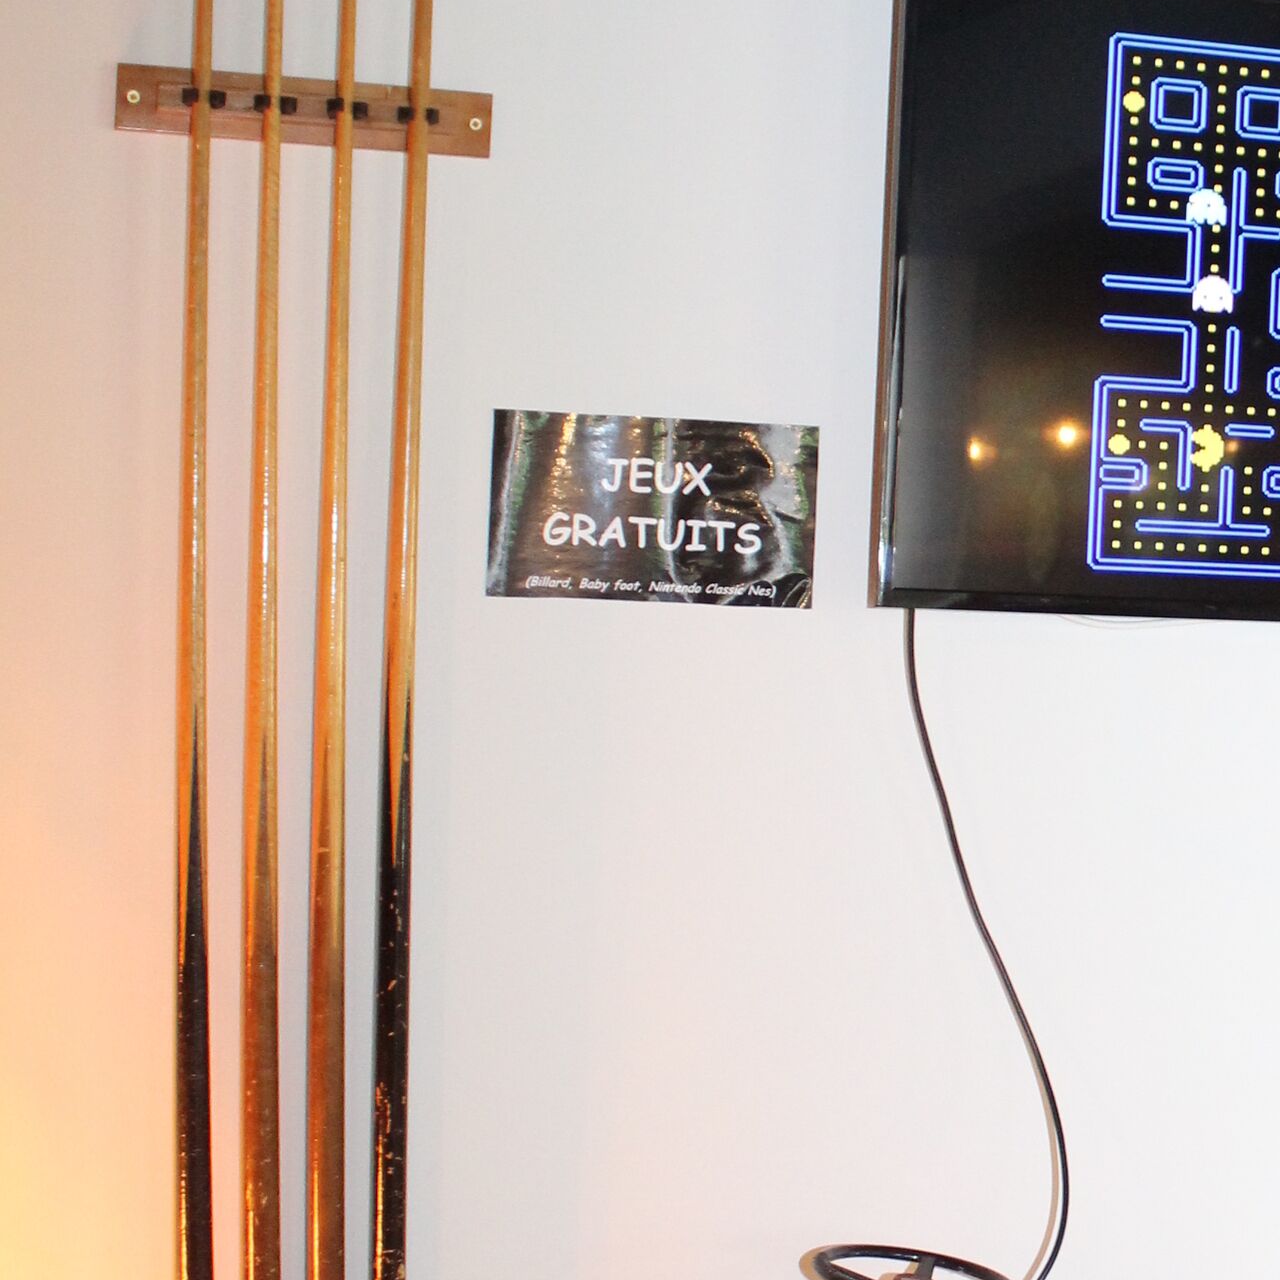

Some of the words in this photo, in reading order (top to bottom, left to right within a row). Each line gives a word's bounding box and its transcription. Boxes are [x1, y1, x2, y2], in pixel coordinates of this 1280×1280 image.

[600, 457, 713, 497] JEUX
[542, 511, 763, 556] GRATUITS
[525, 575, 572, 589] (Billard,
[579, 577, 611, 593] Baby
[614, 579, 643, 593] foot,
[648, 581, 702, 594] Nintendo
[705, 582, 745, 596] Classic
[747, 584, 777, 599] Nes)
